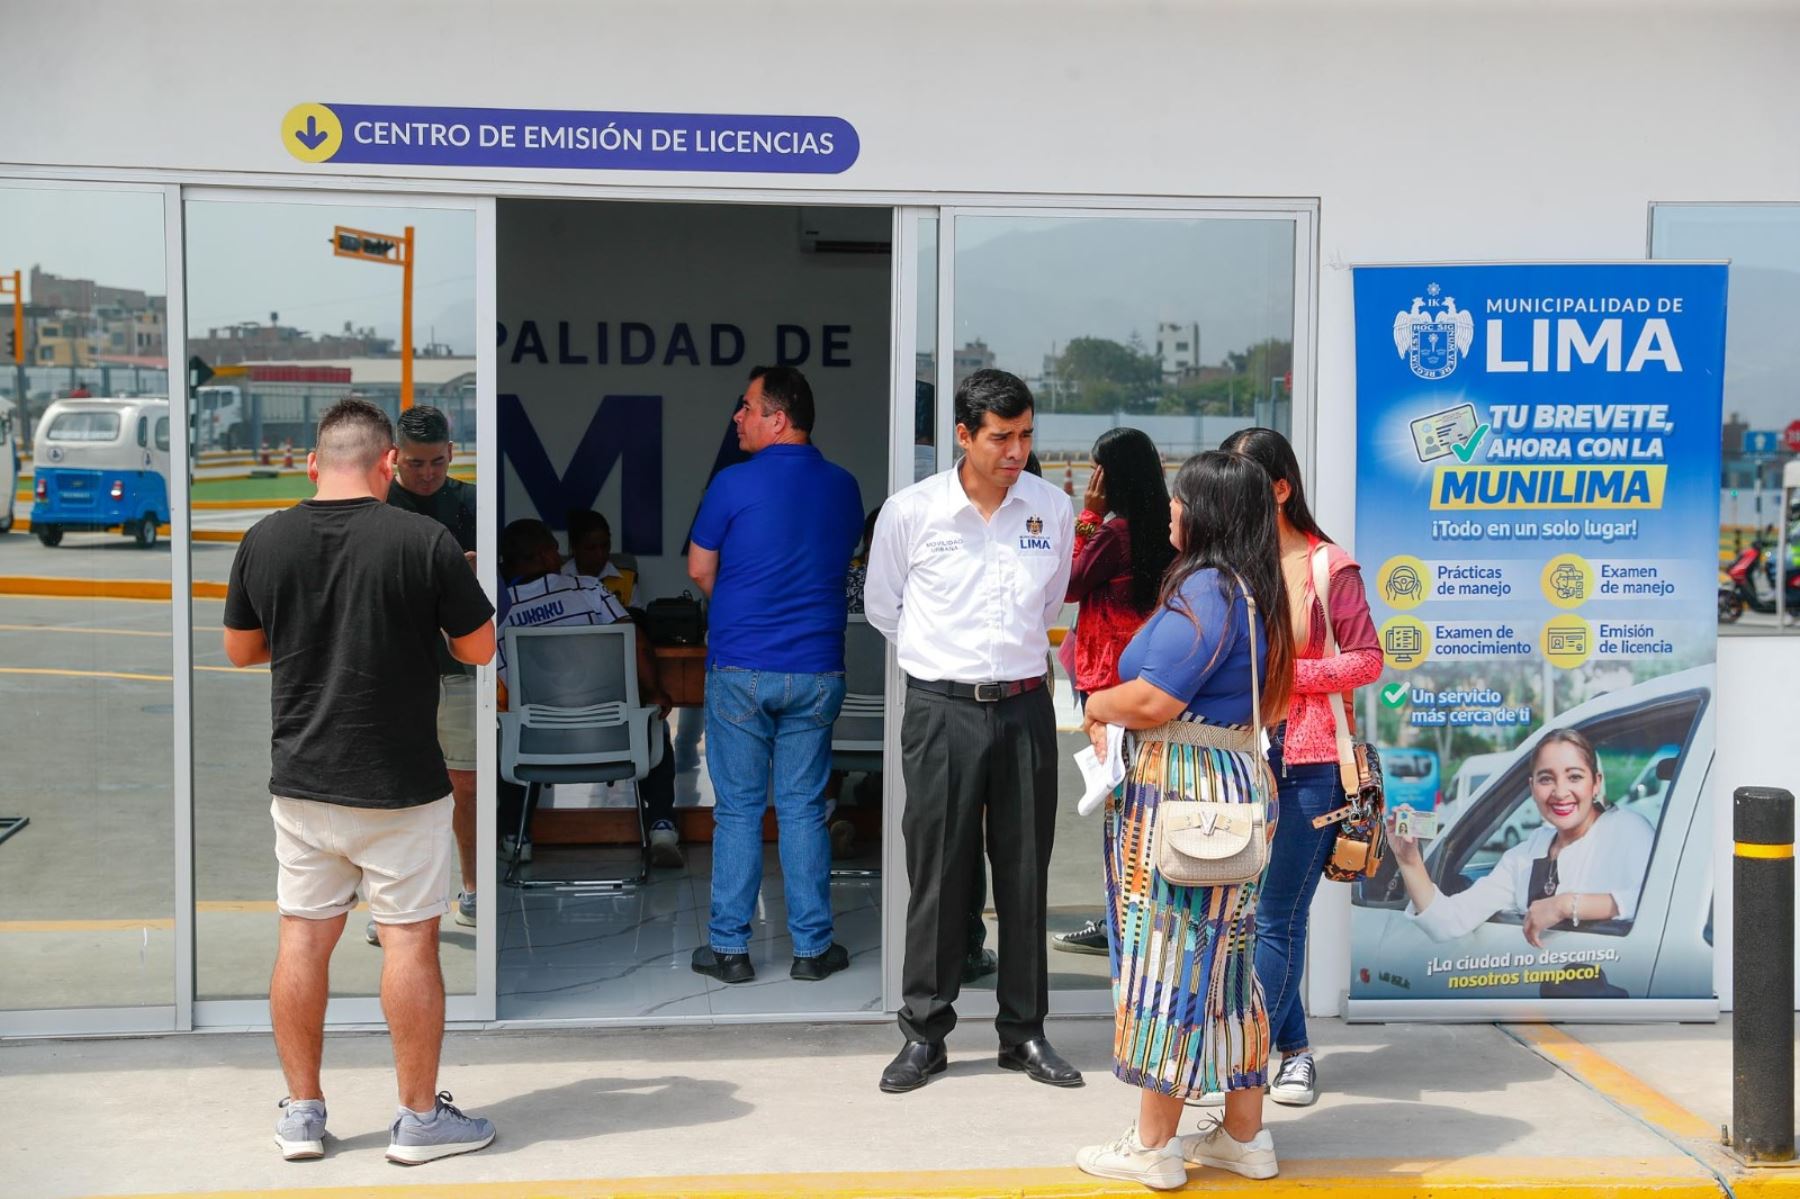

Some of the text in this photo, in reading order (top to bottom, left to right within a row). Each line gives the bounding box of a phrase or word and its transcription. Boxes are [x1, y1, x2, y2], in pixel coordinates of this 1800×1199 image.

[353, 121, 834, 155] CENTRO DE EMISIÓN DE LICENCIAS
[1487, 298, 1684, 313] MUNICIPALIDAD DE
[776, 324, 852, 367] DE
[1486, 318, 1684, 373] LIMA
[1489, 405, 1529, 430] TU
[1533, 405, 1675, 432] BREVETE,
[1487, 438, 1664, 458] AHORA CON LA
[1440, 470, 1651, 505] MUNILIMA
[1432, 519, 1637, 540] ¡Todo en un solo lugar!
[1020, 539, 1051, 550] LIMA
[1437, 564, 1502, 580] Prácticas
[1601, 564, 1657, 578] Examen
[1437, 582, 1512, 597] de manejo
[1600, 580, 1675, 596] de manejo
[509, 600, 565, 626] LUKAKU
[1436, 625, 1514, 639] Examen de
[1600, 622, 1654, 638] Emisión
[1435, 641, 1532, 655] conocimiento
[1600, 639, 1673, 654] de licencia
[1412, 689, 1502, 704] Un servicio
[1412, 707, 1531, 723] más cerca de ti
[1427, 948, 1620, 976] ¡La ciudad no descansa,
[1448, 965, 1600, 988] nosotros tampoco!
